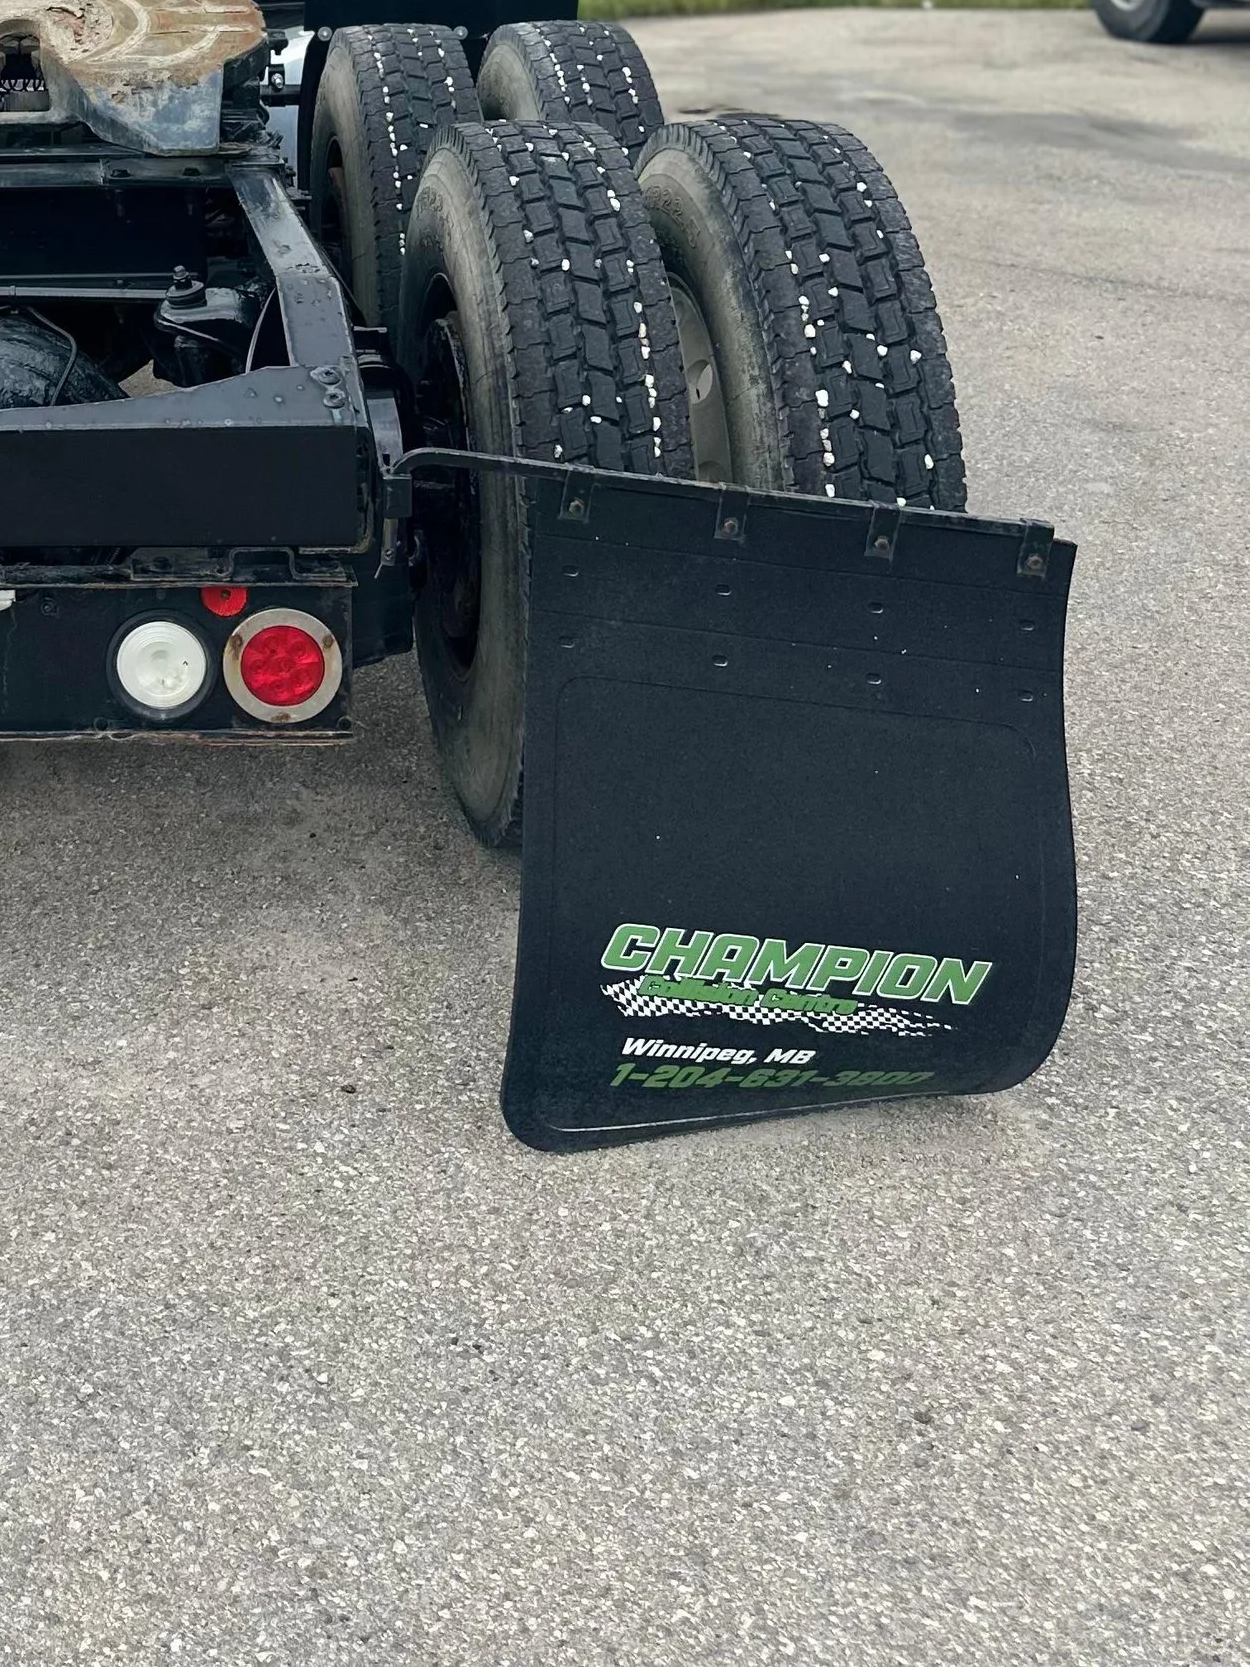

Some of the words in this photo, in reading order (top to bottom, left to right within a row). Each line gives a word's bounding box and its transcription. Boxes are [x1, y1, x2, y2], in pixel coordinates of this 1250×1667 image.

[601, 922, 993, 1006] CHAMPION
[637, 974, 760, 1007] Collision
[621, 1037, 757, 1065] Winnipeg,
[763, 1047, 816, 1065] MB
[610, 1062, 935, 1089] 1-204-631-3800
